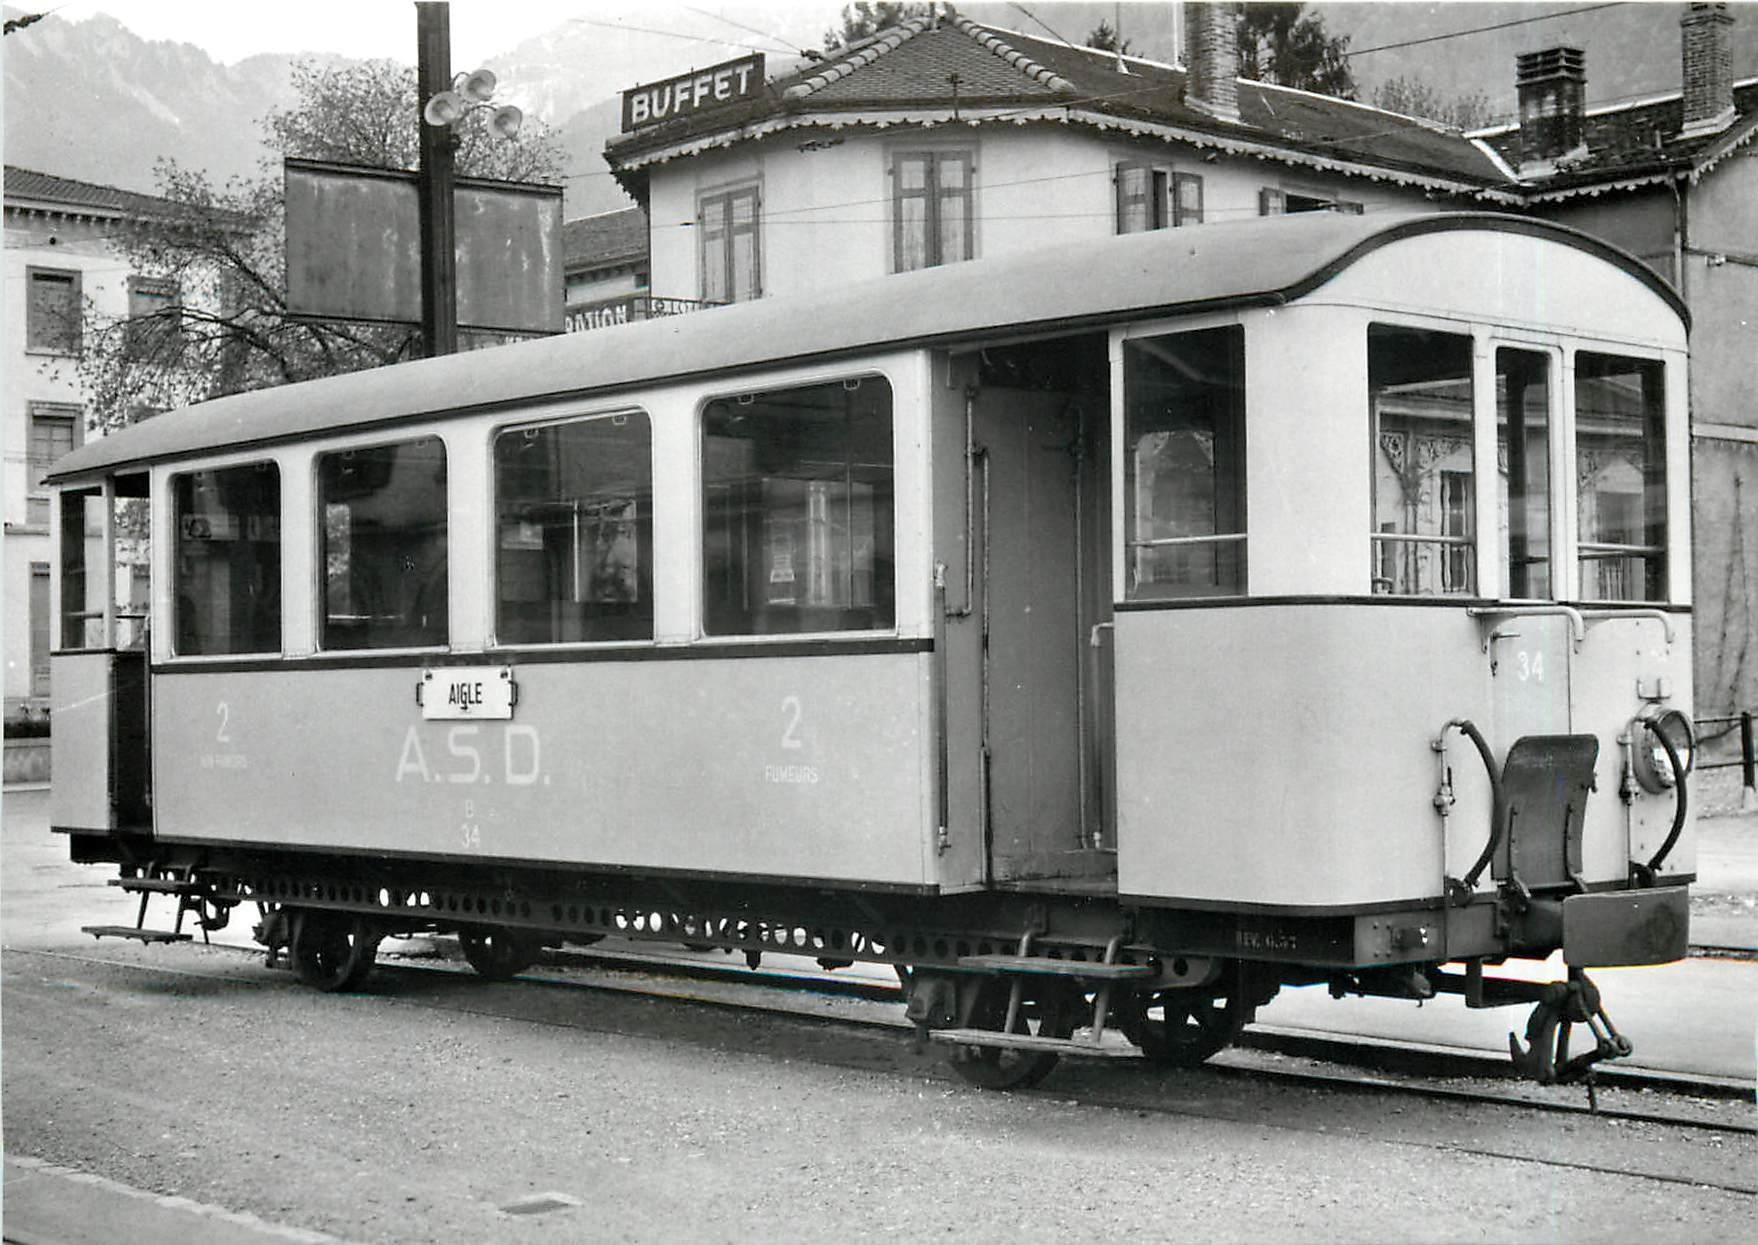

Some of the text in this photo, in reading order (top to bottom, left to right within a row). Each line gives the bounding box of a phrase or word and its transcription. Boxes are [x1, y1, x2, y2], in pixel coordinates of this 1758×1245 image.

[631, 64, 754, 124] BUFFET
[1517, 651, 1544, 682] 34
[448, 682, 482, 710] AIGLE
[216, 701, 229, 742] 2
[782, 695, 801, 749] 2
[395, 724, 552, 785] A.S.D.
[461, 824, 480, 848] 34
